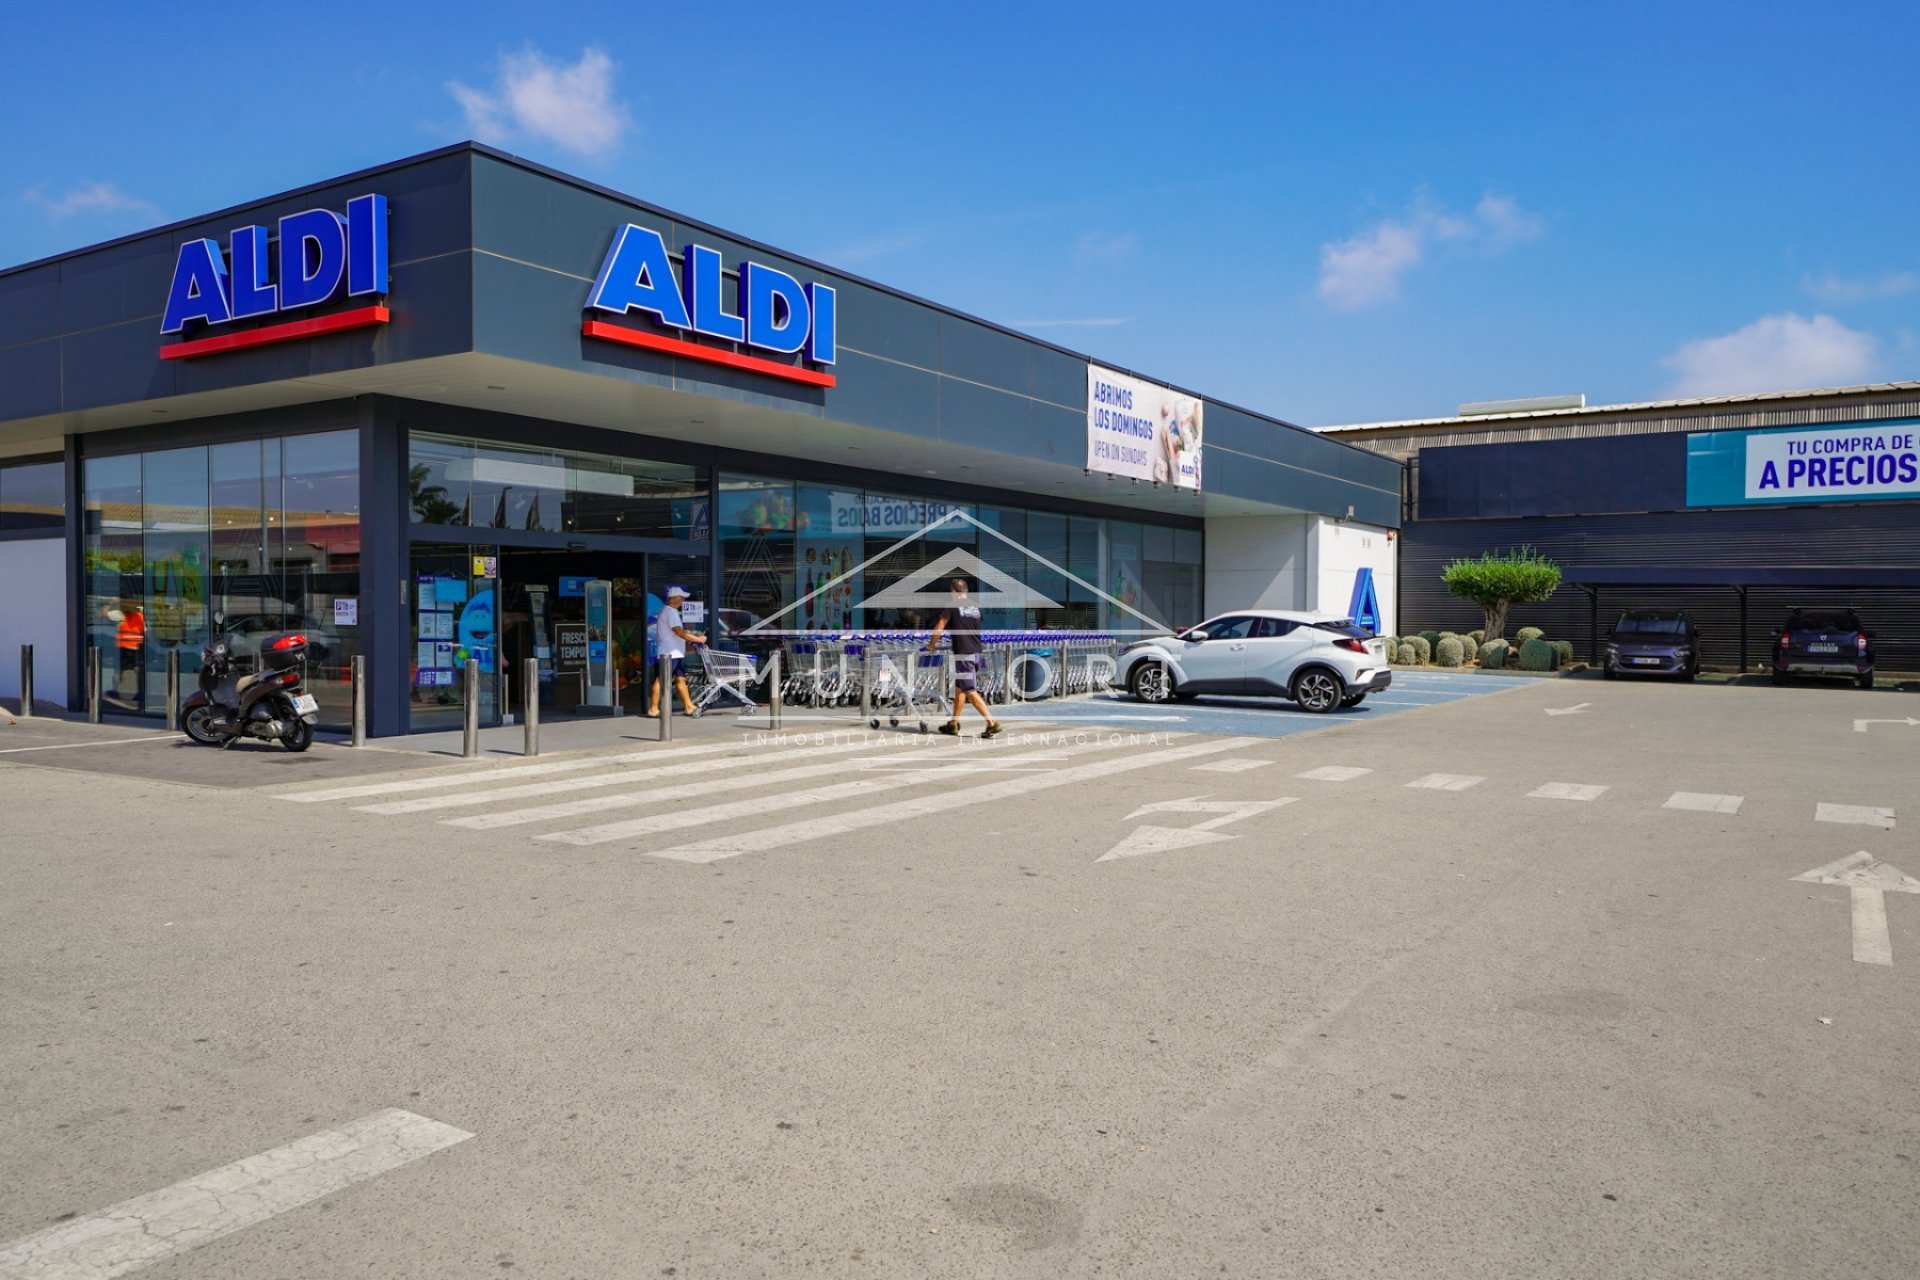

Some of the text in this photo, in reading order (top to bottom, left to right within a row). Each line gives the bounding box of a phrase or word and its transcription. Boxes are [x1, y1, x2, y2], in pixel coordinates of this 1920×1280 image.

[160, 193, 389, 335] ALDI
[584, 223, 836, 365] ALDI
[1093, 380, 1133, 411] ABRIMOS
[1094, 407, 1153, 441] LOS DOMINGOS
[1094, 440, 1110, 459] OPEN
[1121, 445, 1148, 467] SUNDAYS
[1787, 440, 1807, 456] TU
[1812, 436, 1886, 454] COMPRA
[1892, 434, 1914, 450] DE
[1181, 464, 1195, 475] ALDI
[1758, 453, 1918, 490] A PRECIOS
[560, 646, 587, 659] TEMPO
